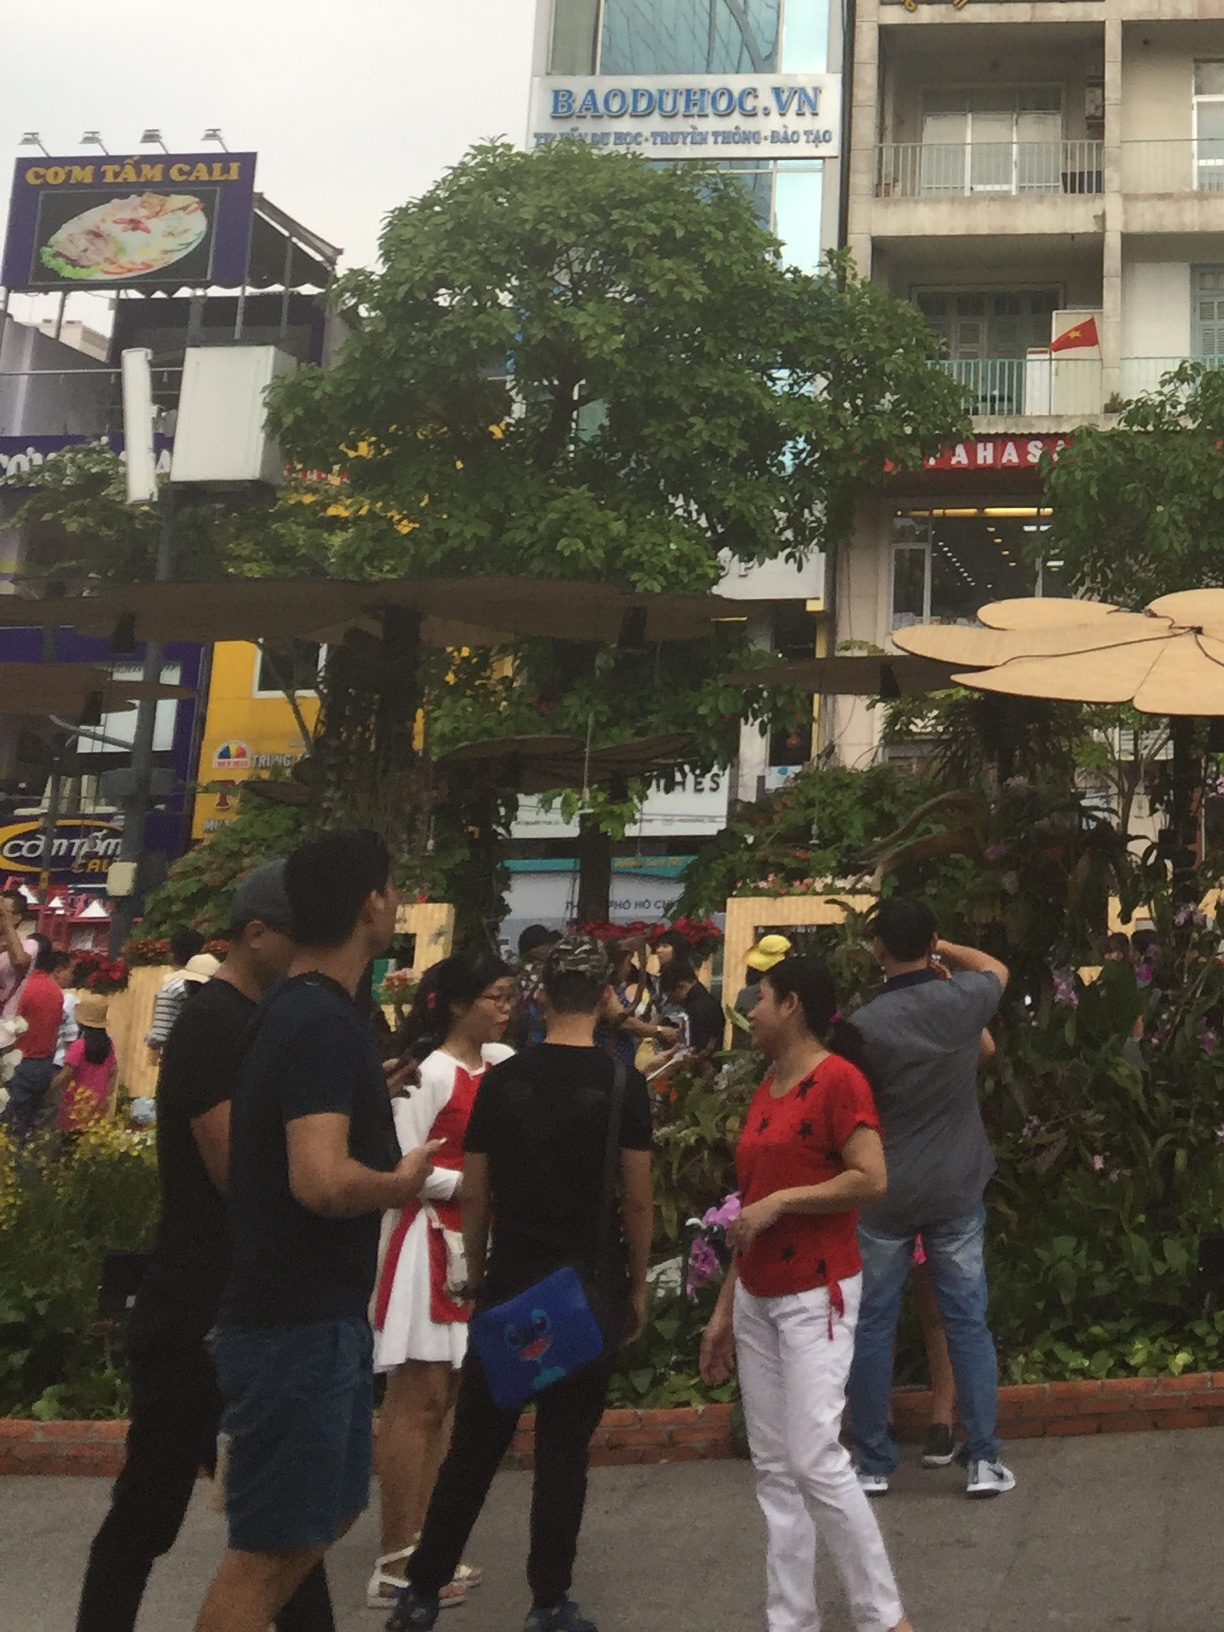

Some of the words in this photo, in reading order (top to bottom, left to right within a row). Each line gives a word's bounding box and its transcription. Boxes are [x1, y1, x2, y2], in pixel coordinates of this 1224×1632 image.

[551, 86, 822, 118] BAODUHOC.VN
[101, 156, 163, 183] TẤM
[169, 163, 241, 181] CALI
